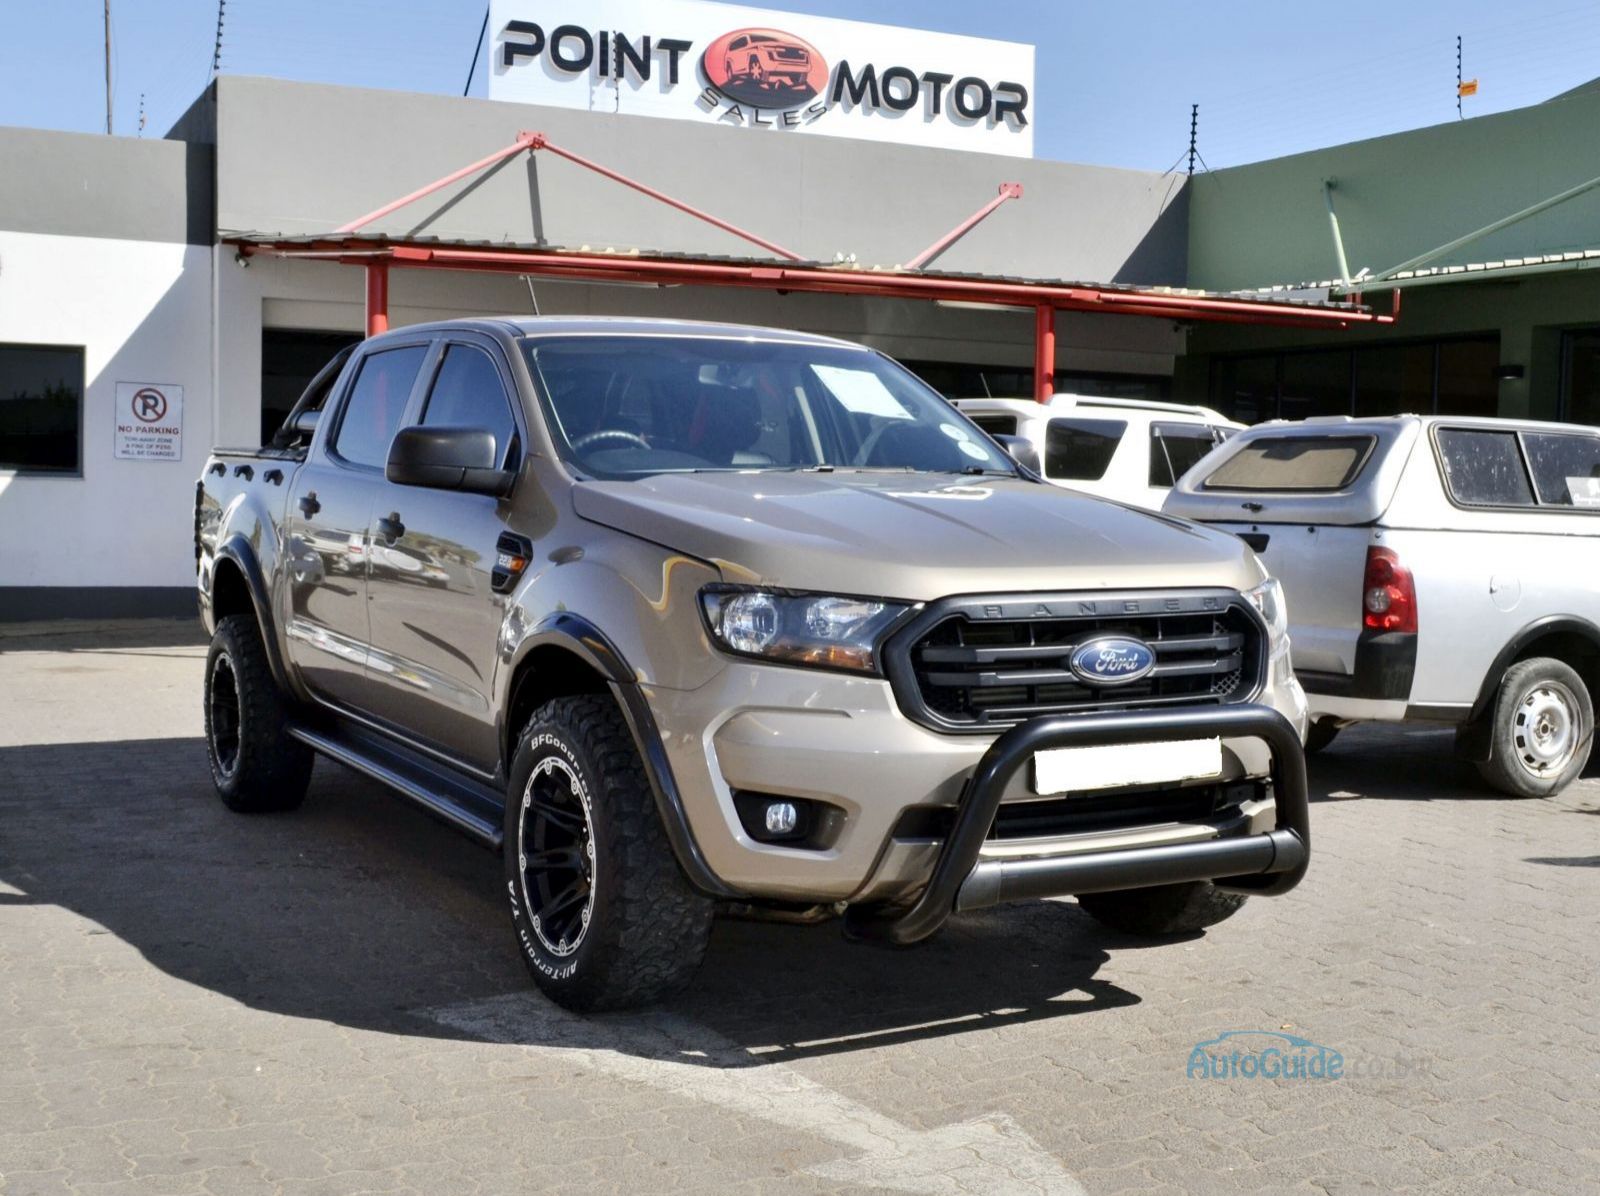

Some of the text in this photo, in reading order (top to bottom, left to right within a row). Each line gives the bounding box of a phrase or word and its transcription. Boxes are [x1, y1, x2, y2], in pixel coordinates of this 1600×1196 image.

[503, 20, 1029, 126] POINT MOTOR
[699, 87, 828, 127] SALES
[118, 425, 179, 435] NO PARKING
[984, 597, 1218, 618] RANGER
[1094, 649, 1138, 672] Ford
[531, 733, 593, 811] BFGoodrich
